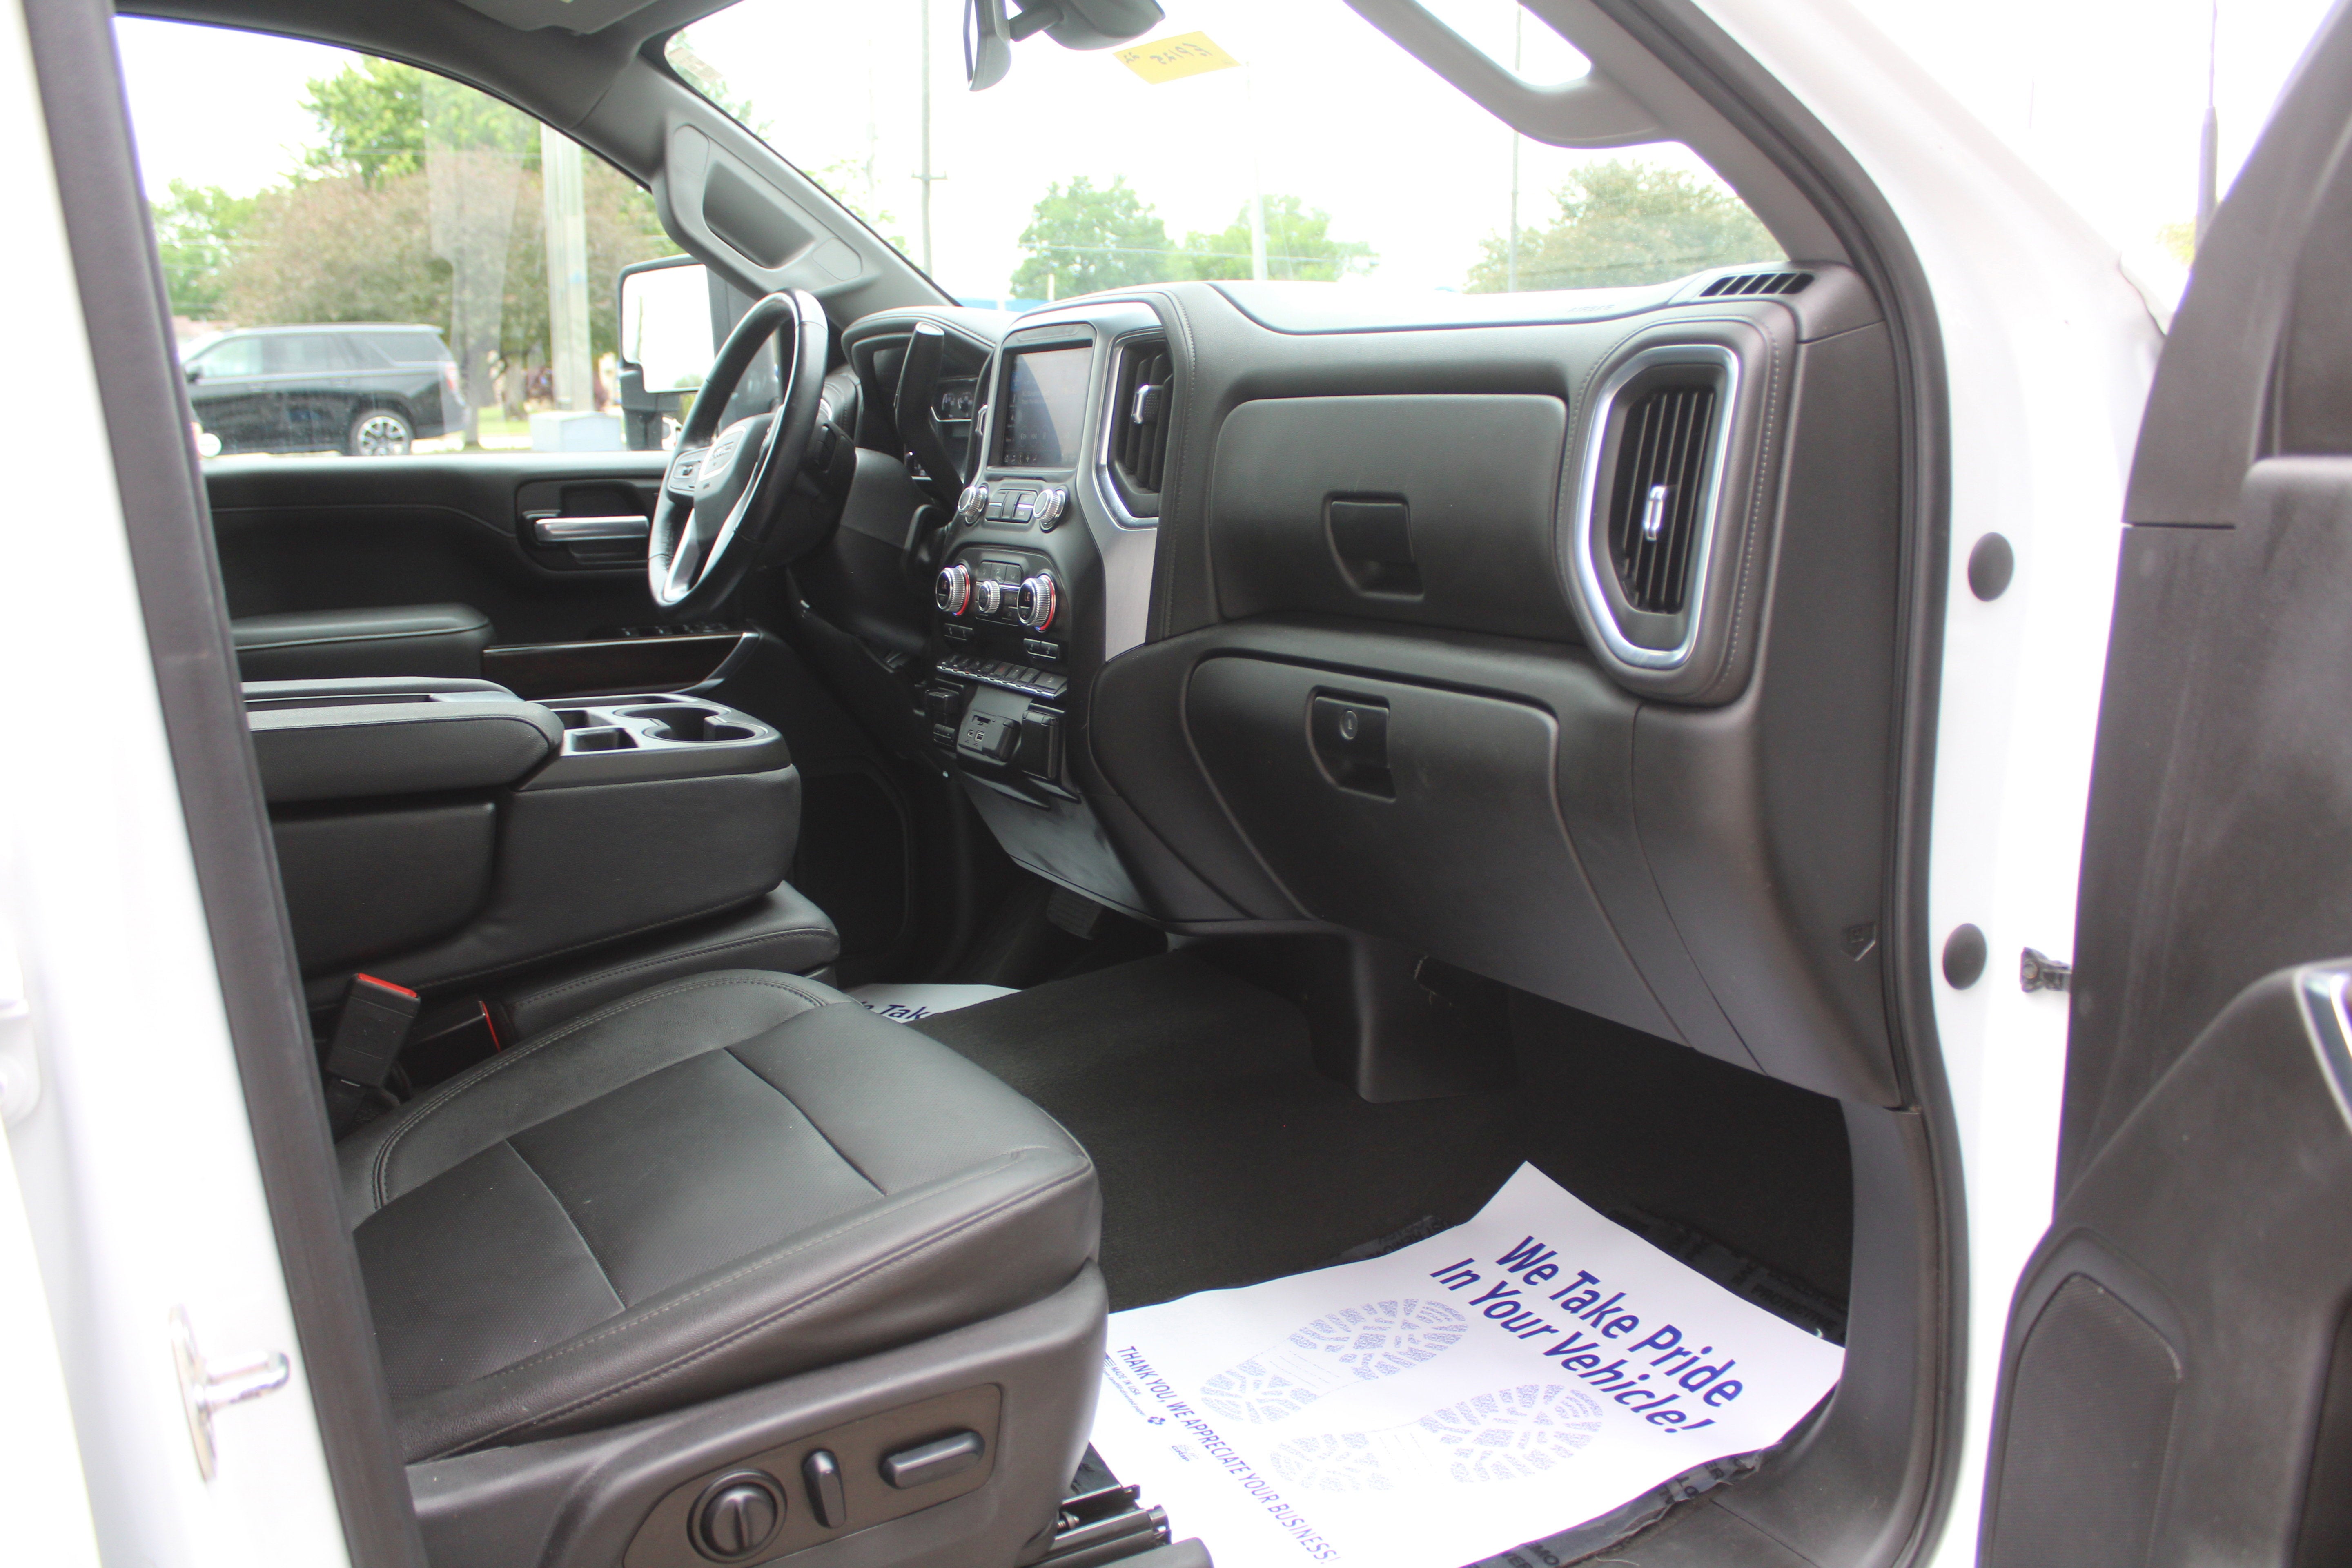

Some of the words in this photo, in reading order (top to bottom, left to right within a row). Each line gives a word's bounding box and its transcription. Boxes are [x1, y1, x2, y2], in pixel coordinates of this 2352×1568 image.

[1495, 1235, 1559, 1285] We
[1548, 1270, 1639, 1339] Take
[1627, 1324, 1743, 1407] Pride
[1429, 1258, 1481, 1291] In
[1468, 1280, 1560, 1339] Your
[1543, 1331, 1716, 1433] Vehicle!
[1117, 1345, 1158, 1379] THANK
[1111, 1366, 1127, 1379] MADE
[1128, 1385, 1142, 1396] USA
[1145, 1378, 1178, 1402] YOU,
[1166, 1401, 1195, 1418] WE
[1171, 1445, 1190, 1462] GRIP
[1180, 1419, 1251, 1474] APPRECIATE
[1238, 1472, 1280, 1503] YOUR
[1267, 1503, 1341, 1564] BUSINESS!
